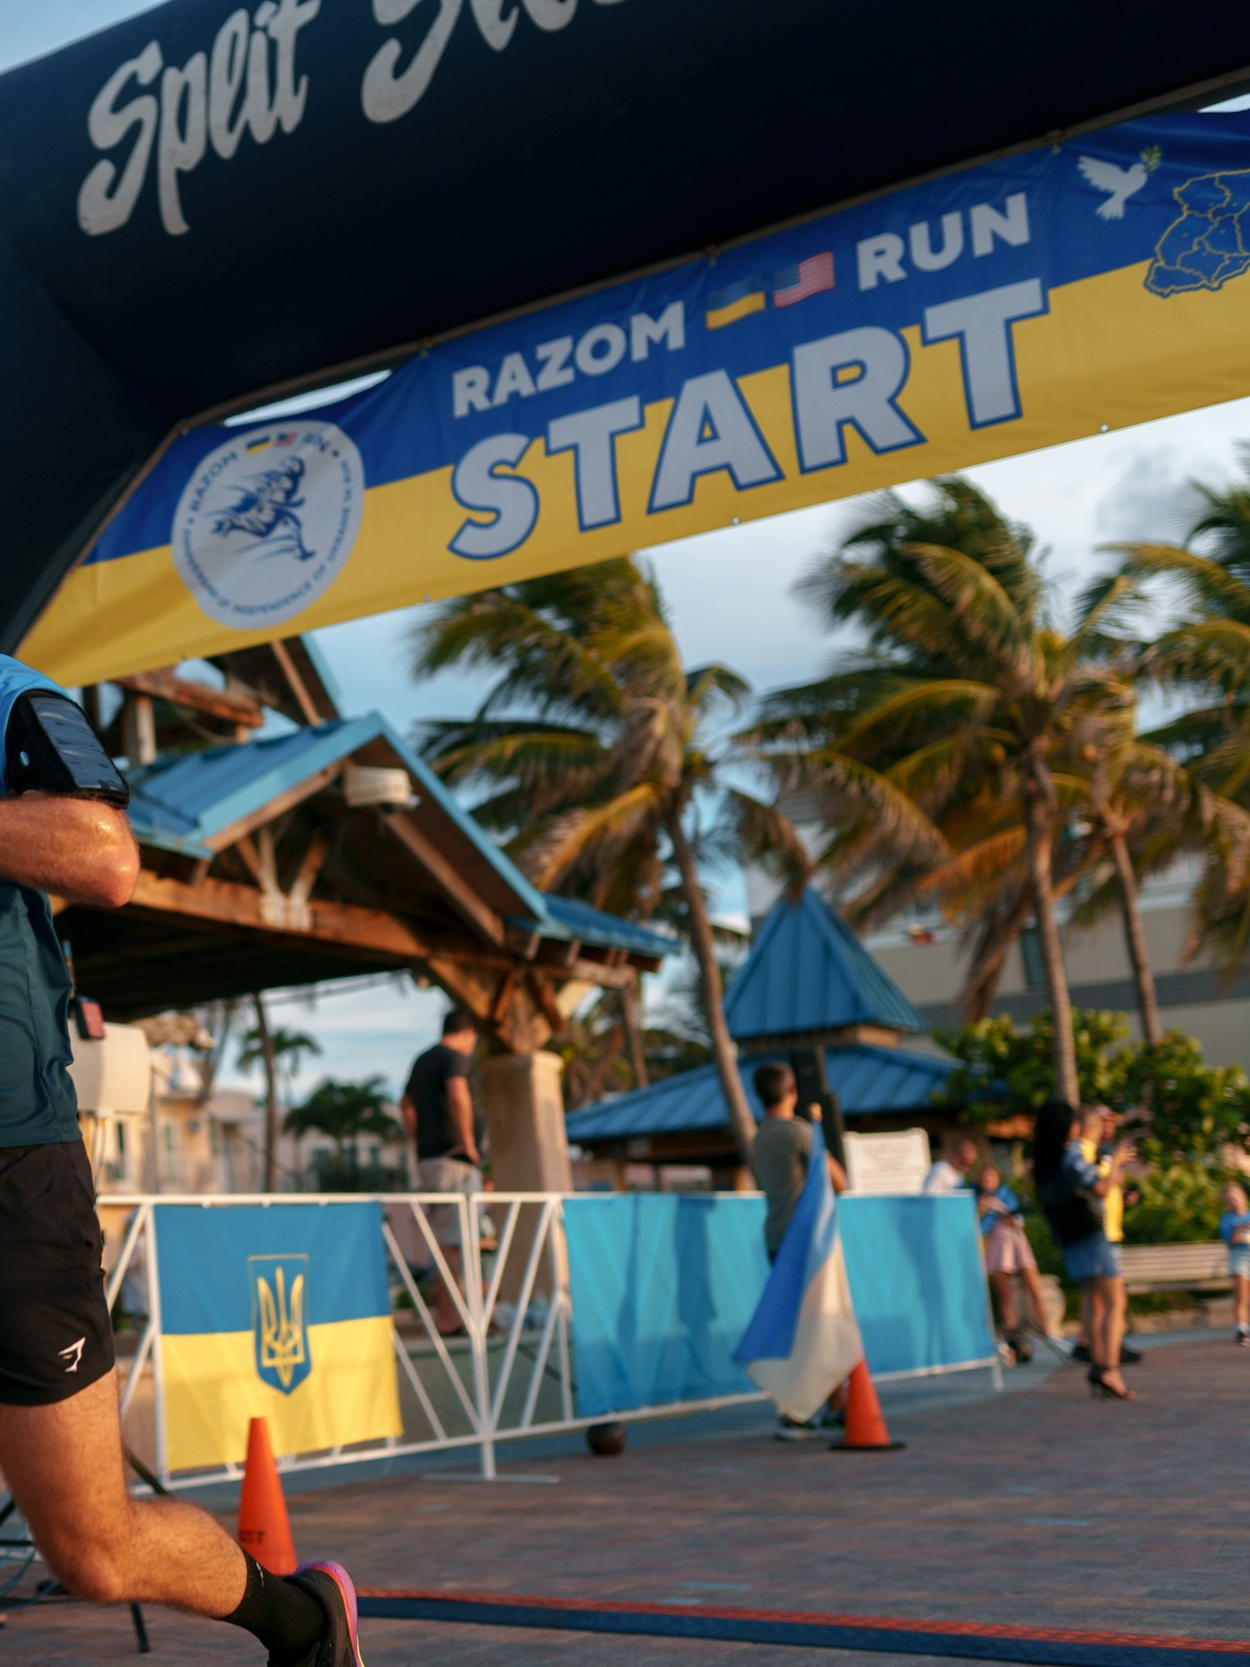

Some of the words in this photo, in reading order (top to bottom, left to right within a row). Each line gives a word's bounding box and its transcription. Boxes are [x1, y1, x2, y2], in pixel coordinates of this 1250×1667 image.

[78, 0, 321, 236] Split
[447, 277, 1050, 561] START
[452, 300, 686, 419] RAZOM
[855, 192, 1031, 292] RUN
